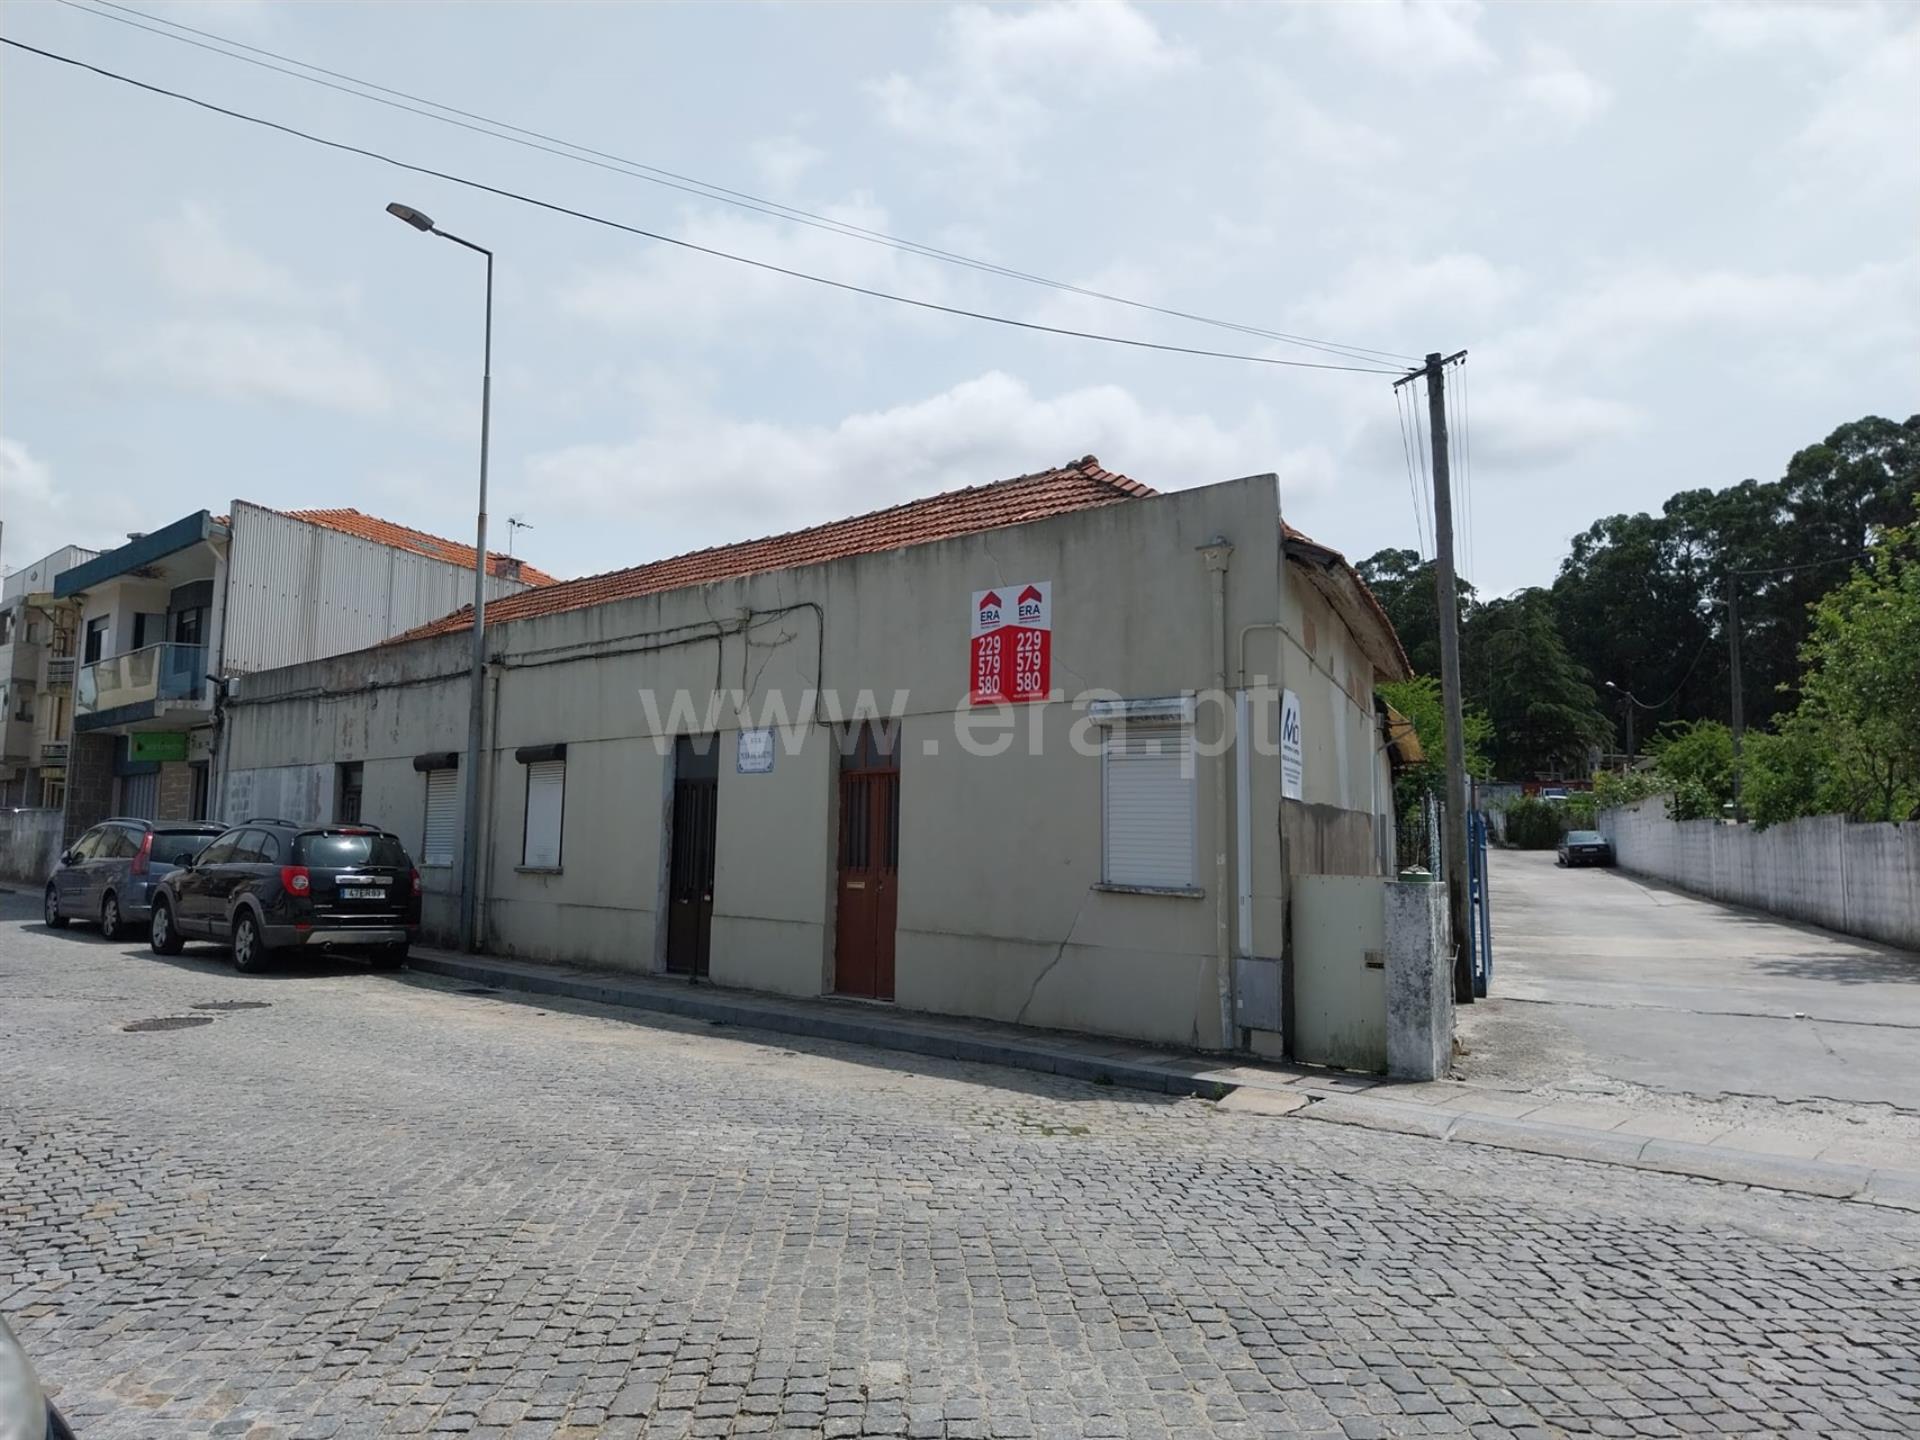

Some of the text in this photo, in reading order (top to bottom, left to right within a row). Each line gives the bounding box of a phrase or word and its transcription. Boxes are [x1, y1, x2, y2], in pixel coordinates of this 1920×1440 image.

[980, 609, 1000, 622] ERA
[1018, 604, 1040, 617] ERA
[978, 635, 1001, 657] 229
[1016, 630, 1041, 652] 229
[978, 655, 1001, 676] 579
[1016, 651, 1041, 672] 579
[978, 674, 1000, 695] 580
[1016, 671, 1041, 692] 580
